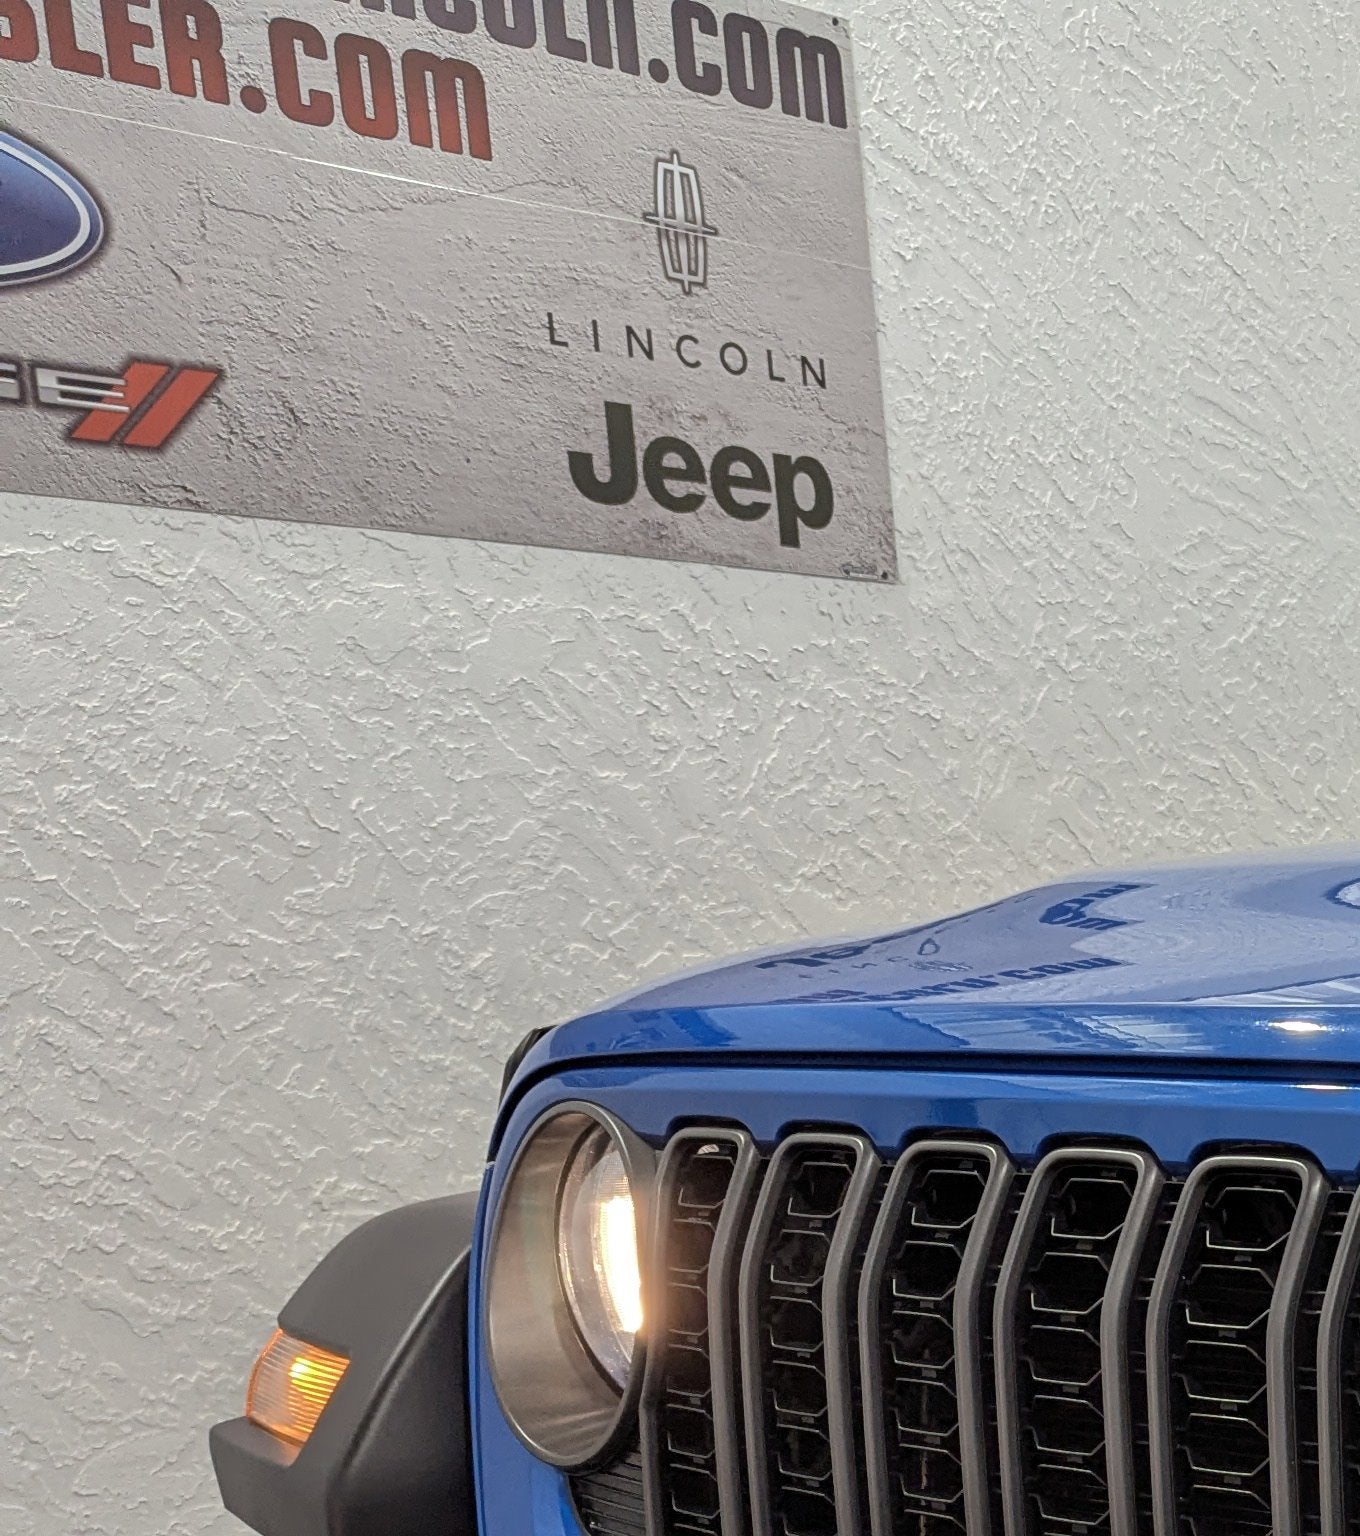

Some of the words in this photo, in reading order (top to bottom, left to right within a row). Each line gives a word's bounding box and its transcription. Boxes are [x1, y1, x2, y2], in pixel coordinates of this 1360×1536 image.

[333, 0, 849, 129] LN.COM
[546, 311, 827, 390] LINCOLN
[566, 400, 835, 549] Jeep
